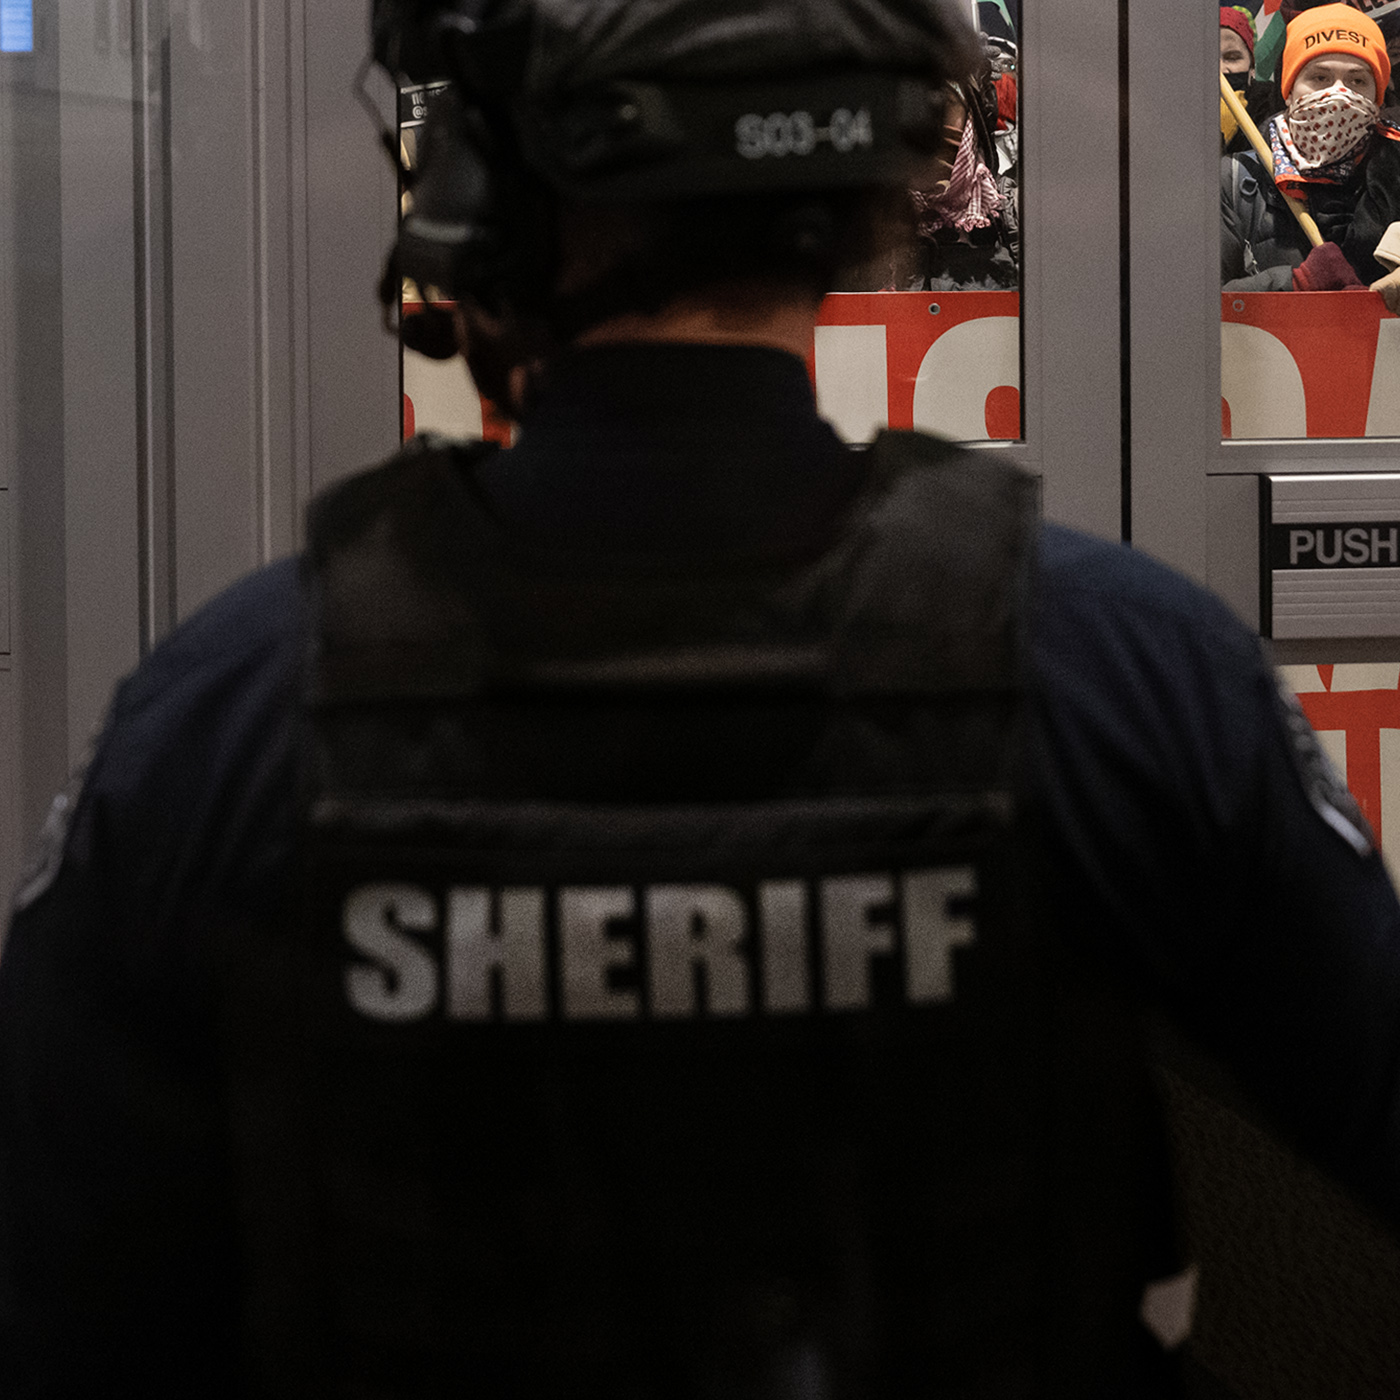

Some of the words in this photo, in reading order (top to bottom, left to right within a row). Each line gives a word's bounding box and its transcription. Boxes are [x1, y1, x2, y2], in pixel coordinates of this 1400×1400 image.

[1305, 29, 1369, 49] DIVEST
[1288, 527, 1399, 567] PUSH
[341, 864, 979, 1025] SHERIFF
